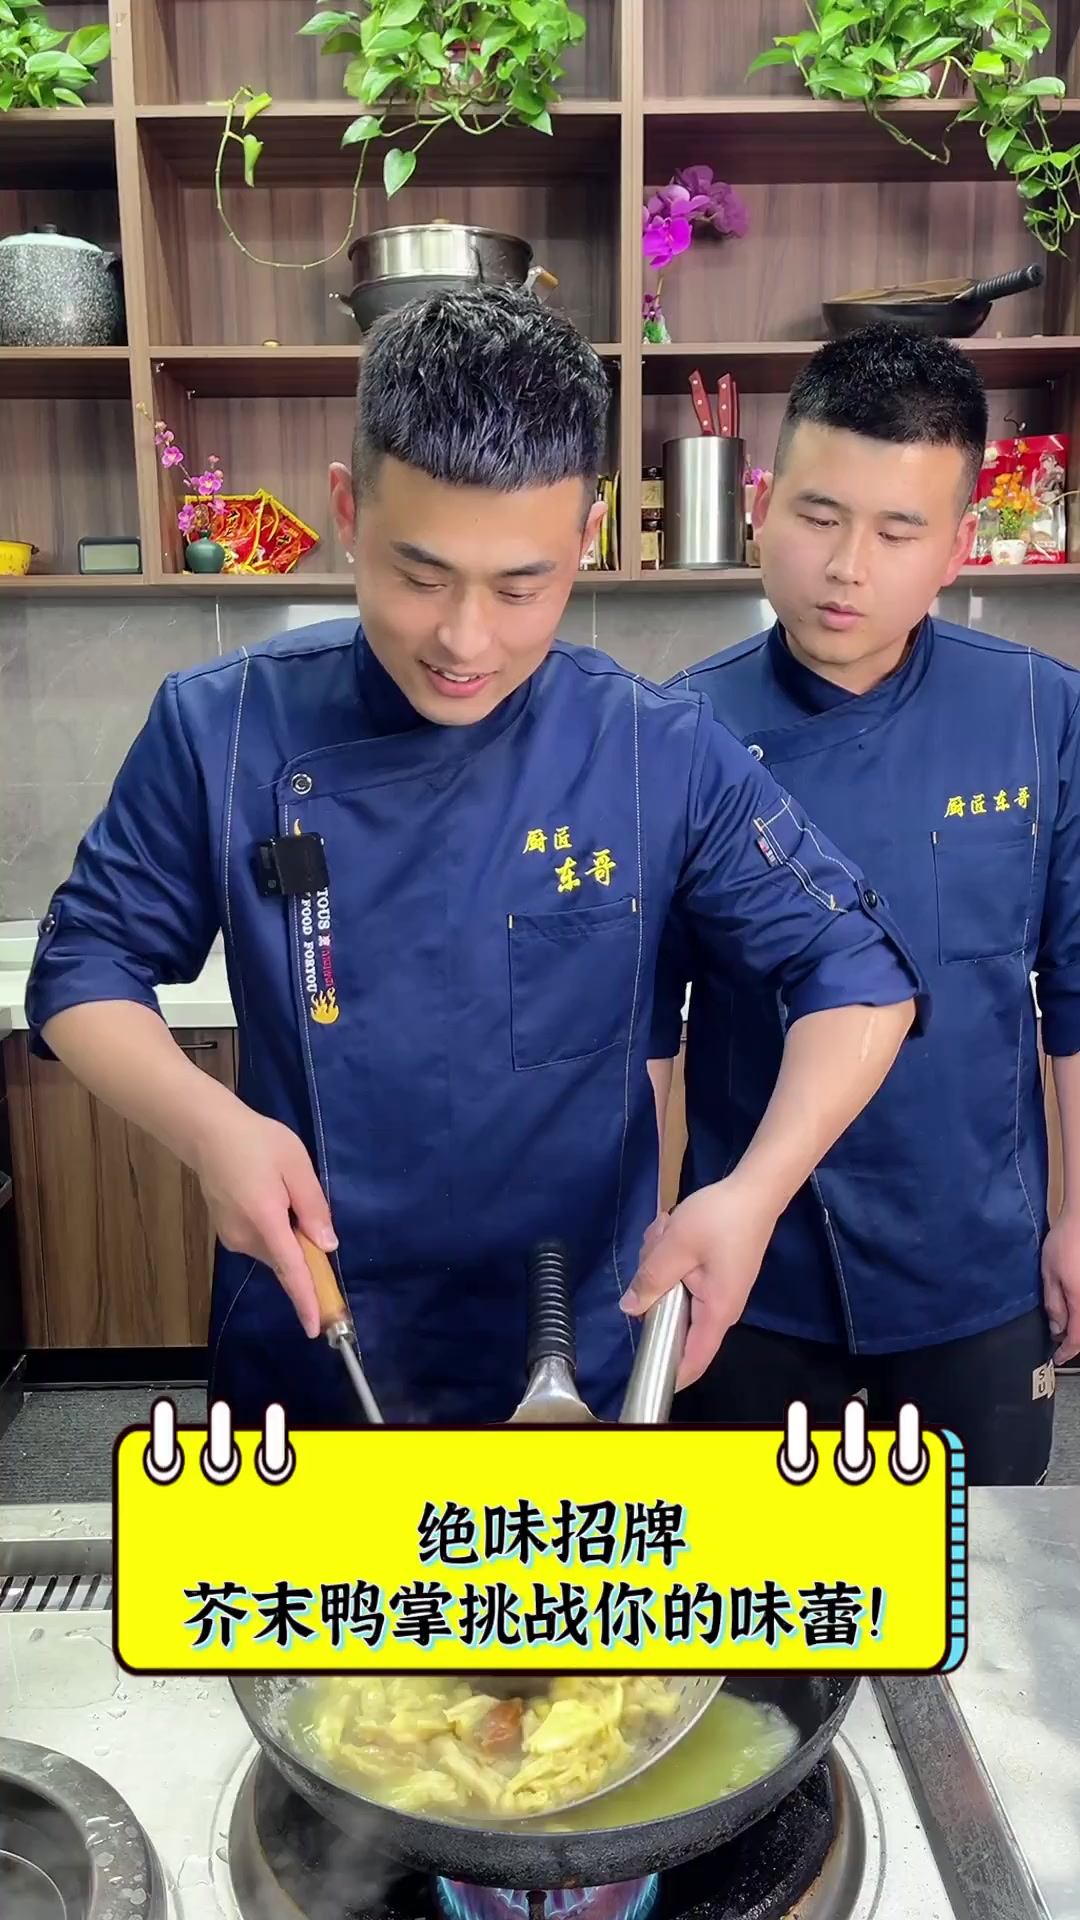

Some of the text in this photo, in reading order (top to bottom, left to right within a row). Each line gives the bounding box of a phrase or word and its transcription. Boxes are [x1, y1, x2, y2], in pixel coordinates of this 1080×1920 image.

[943, 786, 1030, 818] 厨匠东哥
[522, 825, 573, 854] 厨匠
[554, 848, 617, 893] 东哥
